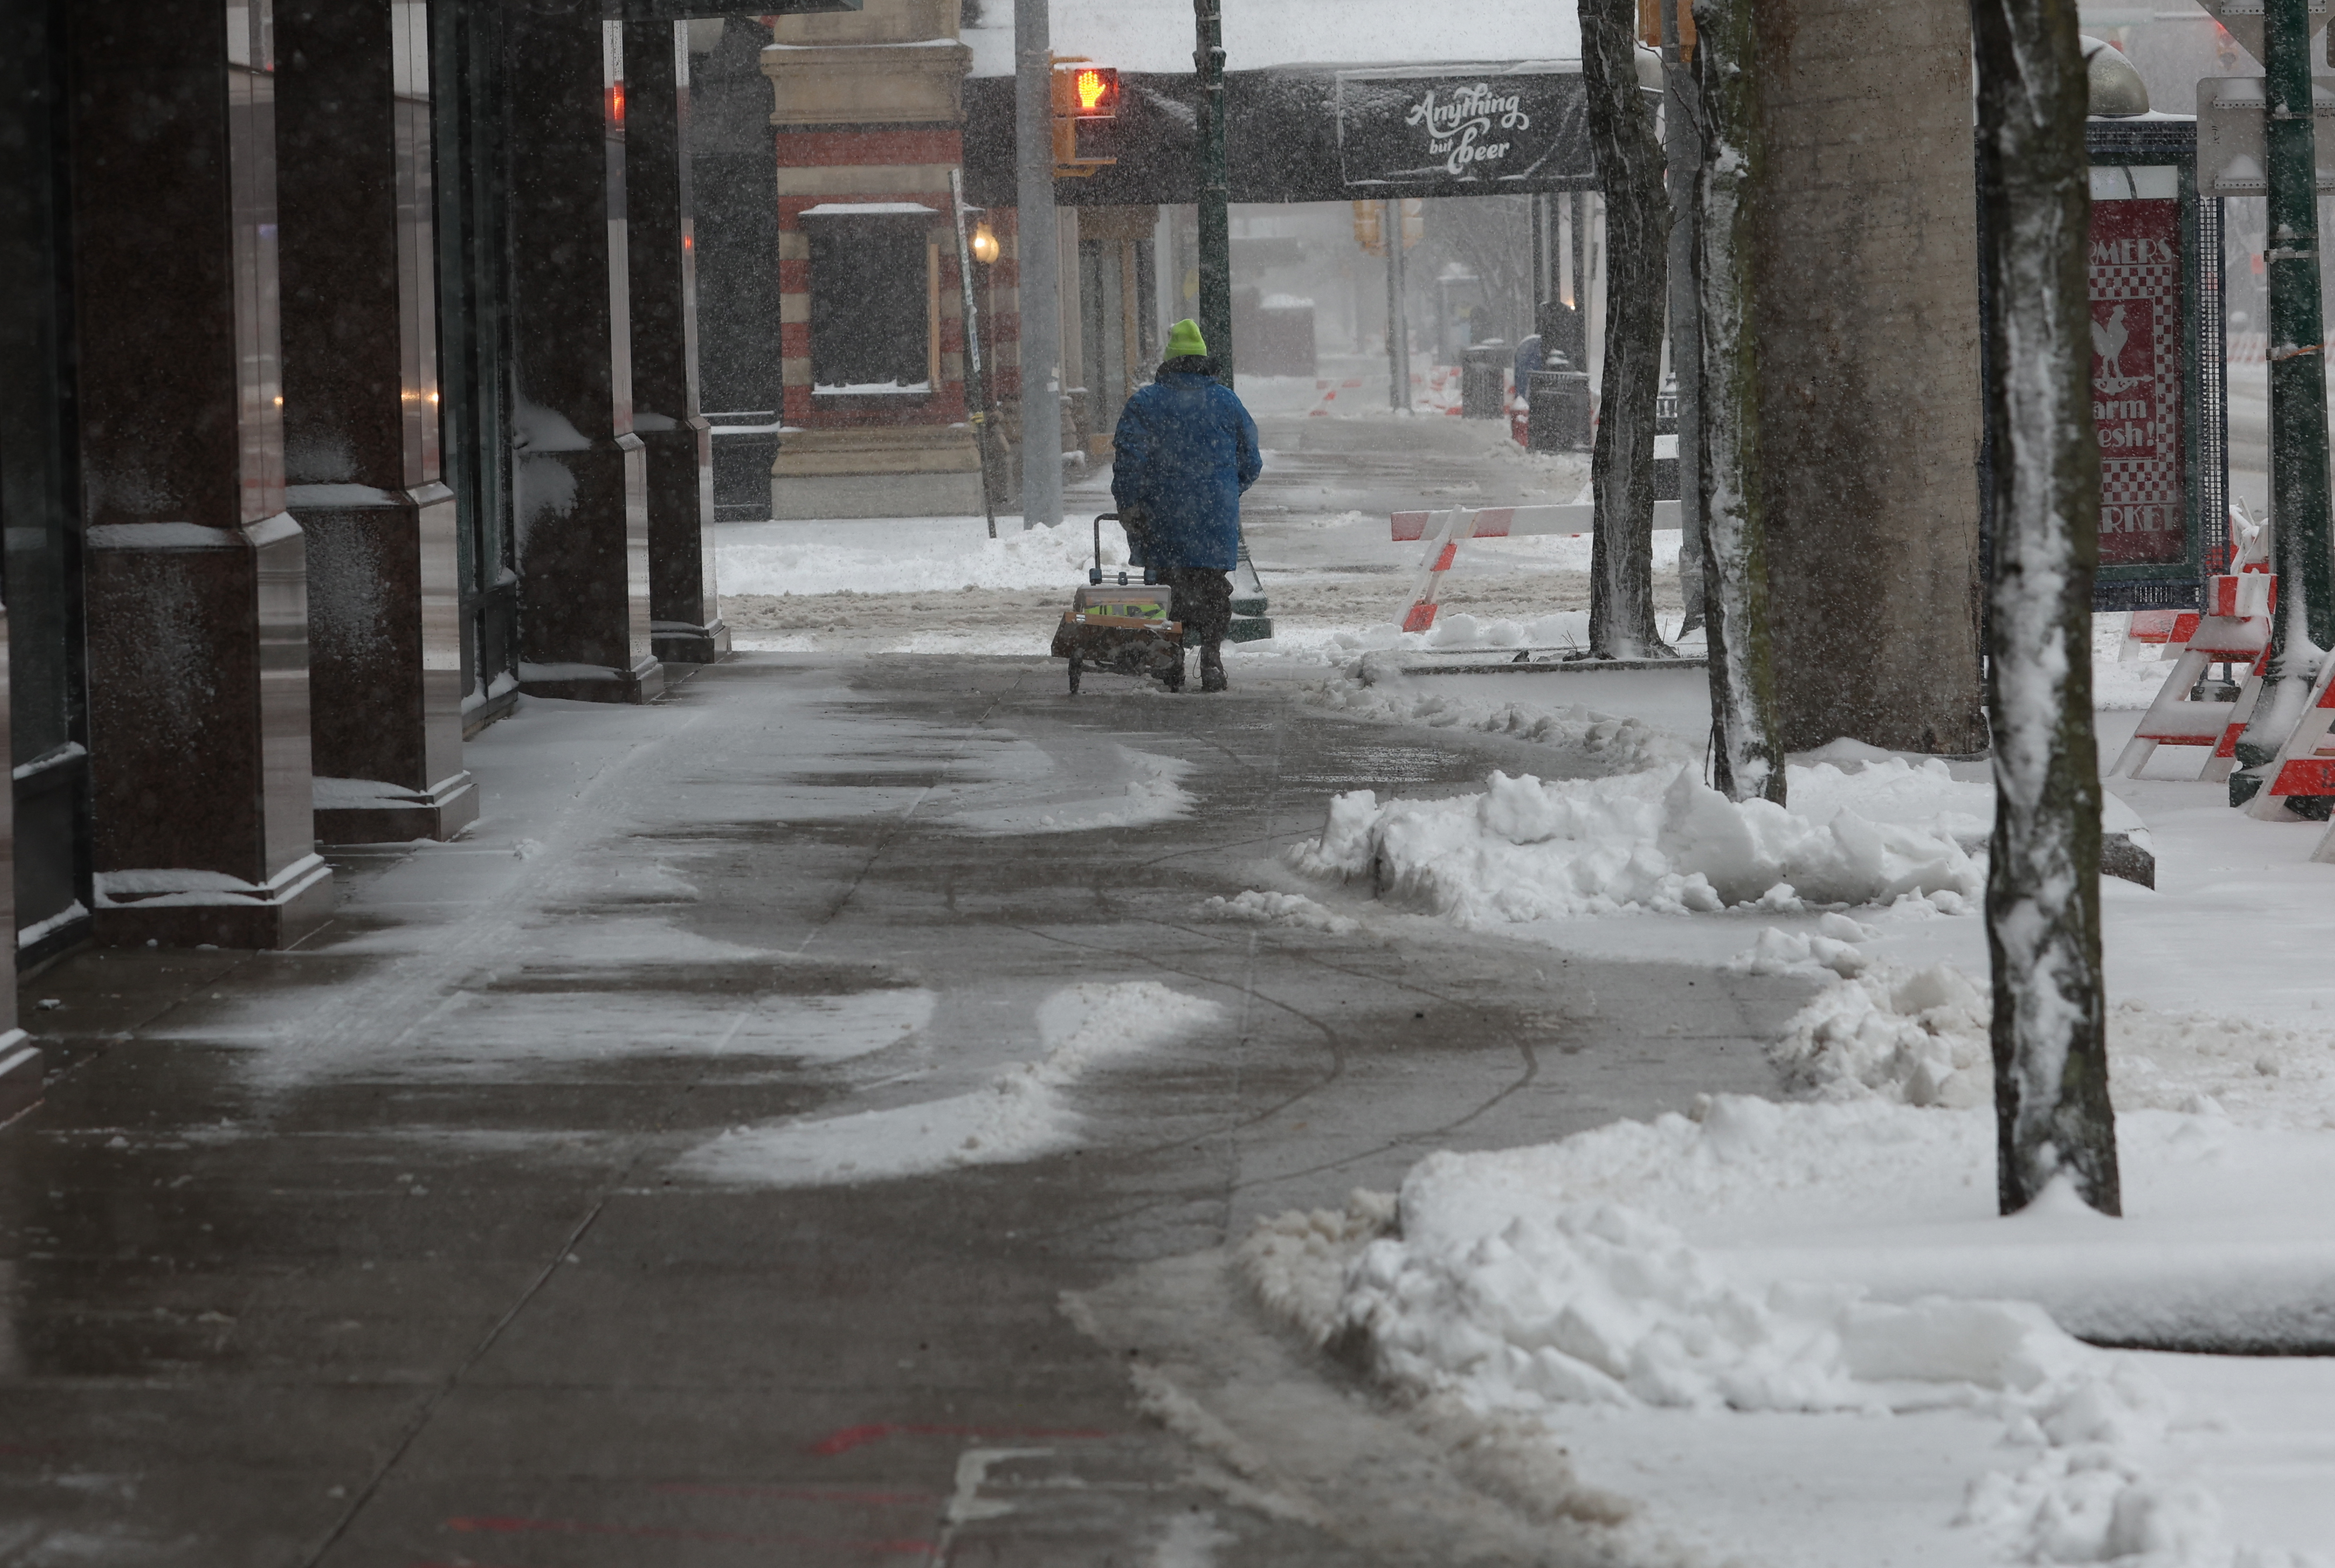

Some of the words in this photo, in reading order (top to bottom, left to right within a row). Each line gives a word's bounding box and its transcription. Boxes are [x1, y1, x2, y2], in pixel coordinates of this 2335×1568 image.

[1405, 83, 1529, 139] Anything
[1429, 139, 1454, 154] but
[2089, 237, 2172, 264] RMERS
[2093, 400, 2147, 420] arm
[2097, 421, 2154, 448] esh!
[2098, 504, 2177, 533] RKET
